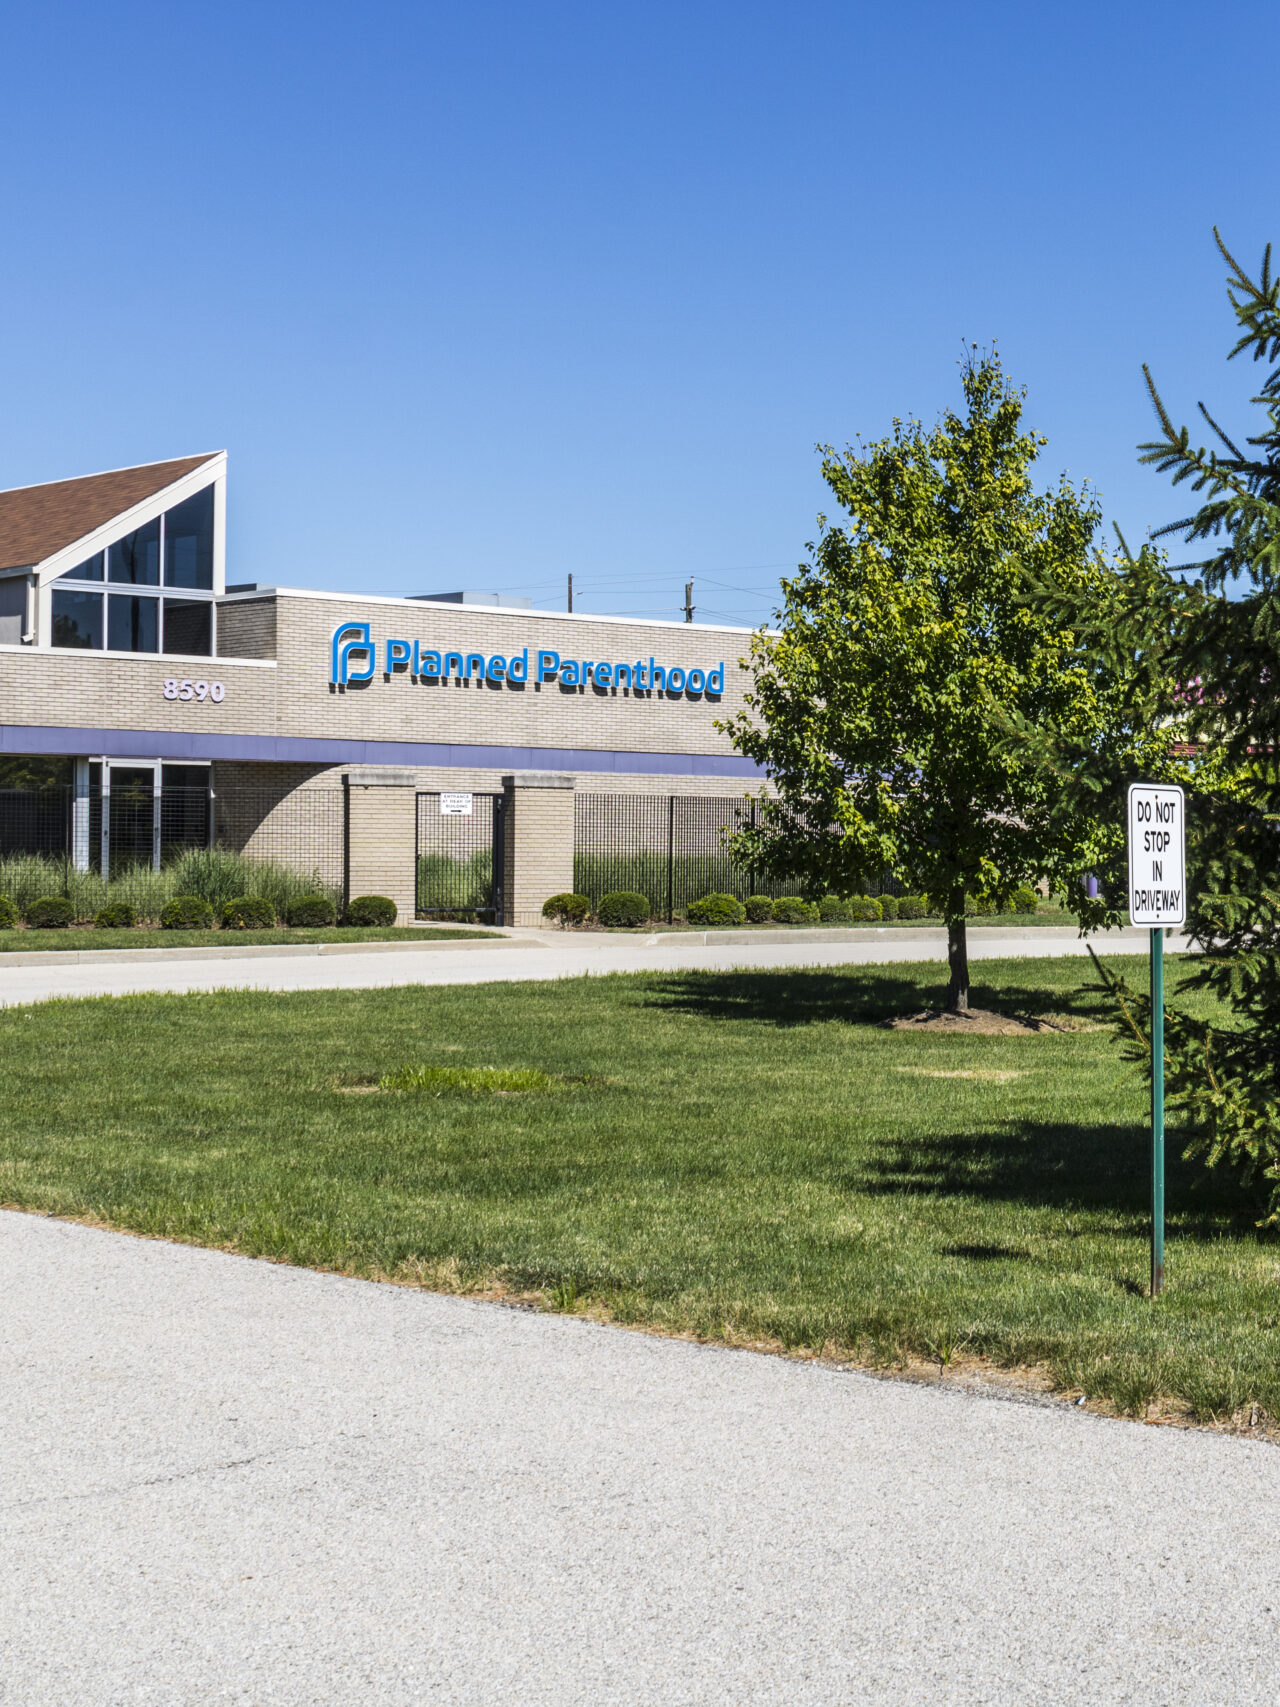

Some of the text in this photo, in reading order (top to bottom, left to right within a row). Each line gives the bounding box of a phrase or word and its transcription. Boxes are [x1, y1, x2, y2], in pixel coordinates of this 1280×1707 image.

[385, 639, 725, 695] Planned Parenthood
[163, 678, 225, 704] 8590
[1137, 801, 1176, 823] DO NOT
[1143, 830, 1171, 852] STOP
[1152, 860, 1163, 882] IN
[1134, 889, 1181, 911] DRIVEWAY
